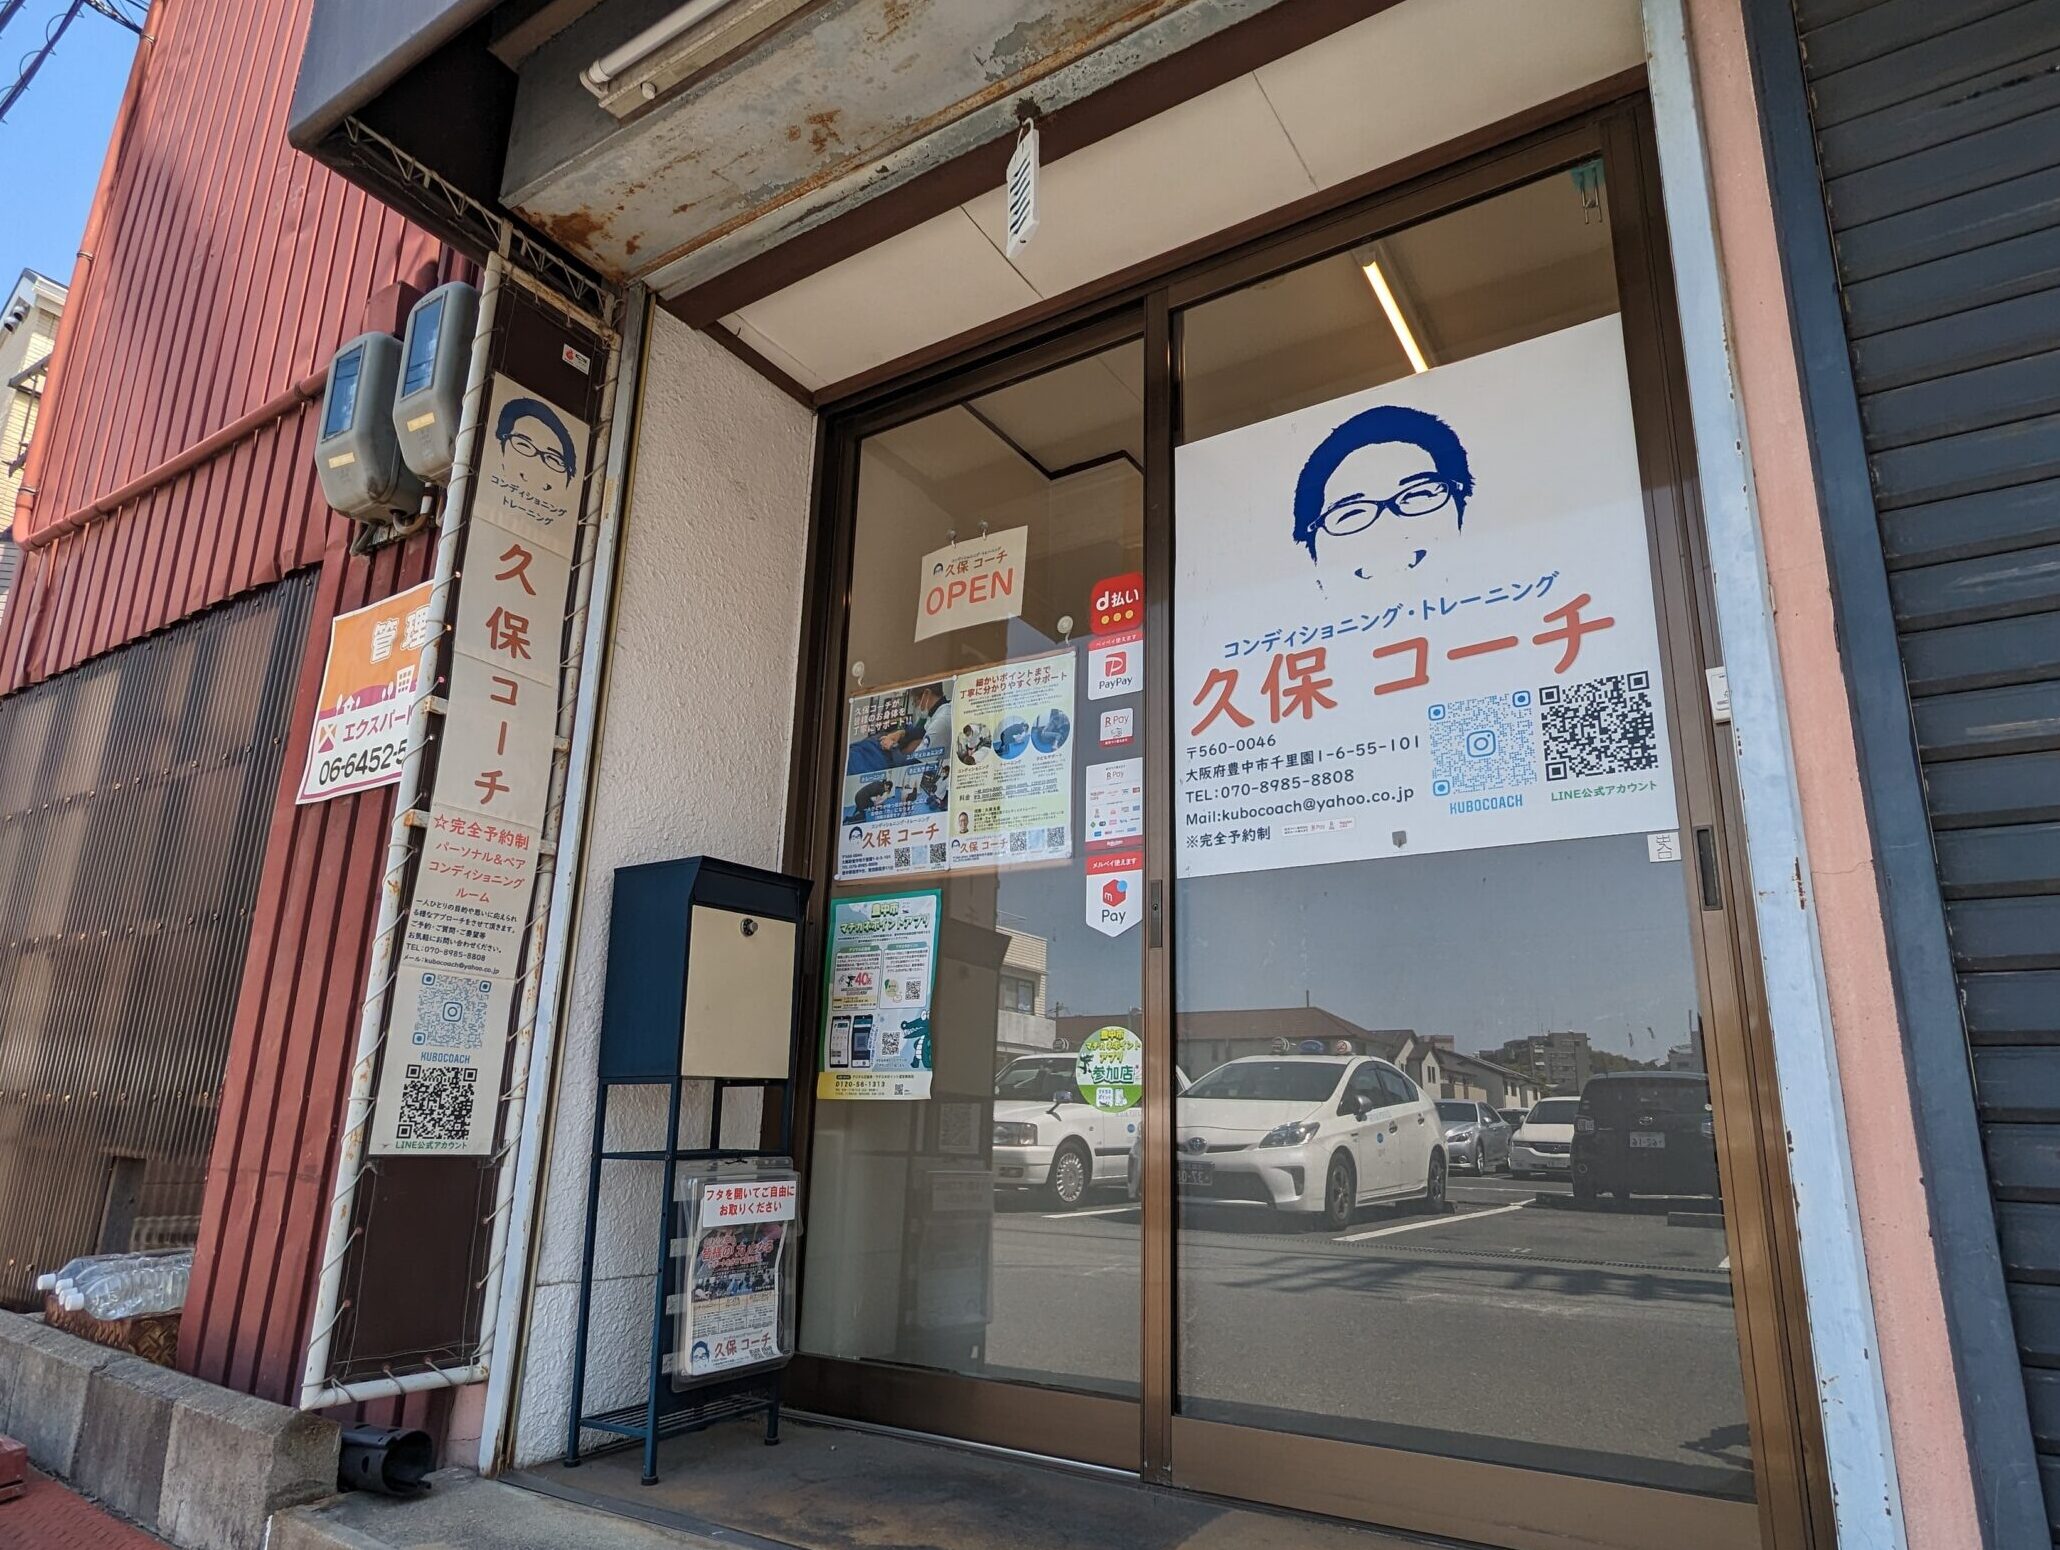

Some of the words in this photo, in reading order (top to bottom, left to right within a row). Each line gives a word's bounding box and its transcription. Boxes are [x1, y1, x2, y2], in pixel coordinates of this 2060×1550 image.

[491, 475, 567, 517] コンディショニング
[503, 495, 554, 526] トレーニング
[926, 567, 1014, 616] OPEN
[1096, 588, 1139, 612] d払い
[1223, 570, 1560, 659] コンディショニング・トレーニング
[1190, 646, 1338, 737] 久保
[1372, 592, 1616, 697] コーチ
[1099, 676, 1132, 690] PayPay
[1113, 715, 1129, 725] Pay
[1186, 735, 1420, 783] 大阪府豊中市千里園1-6-55-101
[1186, 768, 1355, 803] TEL:070-8985-8808
[1551, 779, 1658, 802] LINE公式アカウント
[1186, 785, 1415, 826] Mail:kubocoach@yahoo.co.jp
[1449, 793, 1524, 815] KUBOCOACH
[862, 829, 892, 849] 久保
[897, 823, 940, 842] コーチ
[1656, 834, 1673, 860] 出入口
[428, 860, 526, 890] コンディショニング
[455, 887, 490, 903] ルーム
[1101, 909, 1127, 924] Pay
[421, 1051, 471, 1064] KUBOCOACH
[1092, 1064, 1134, 1083] 参加店
[395, 1140, 467, 1150] LINE公式アカウント
[706, 1185, 795, 1201] フタを開いてご自由に
[719, 1201, 782, 1217] お取りください
[715, 1339, 737, 1359] 久保
[741, 1332, 771, 1351] コーチ
